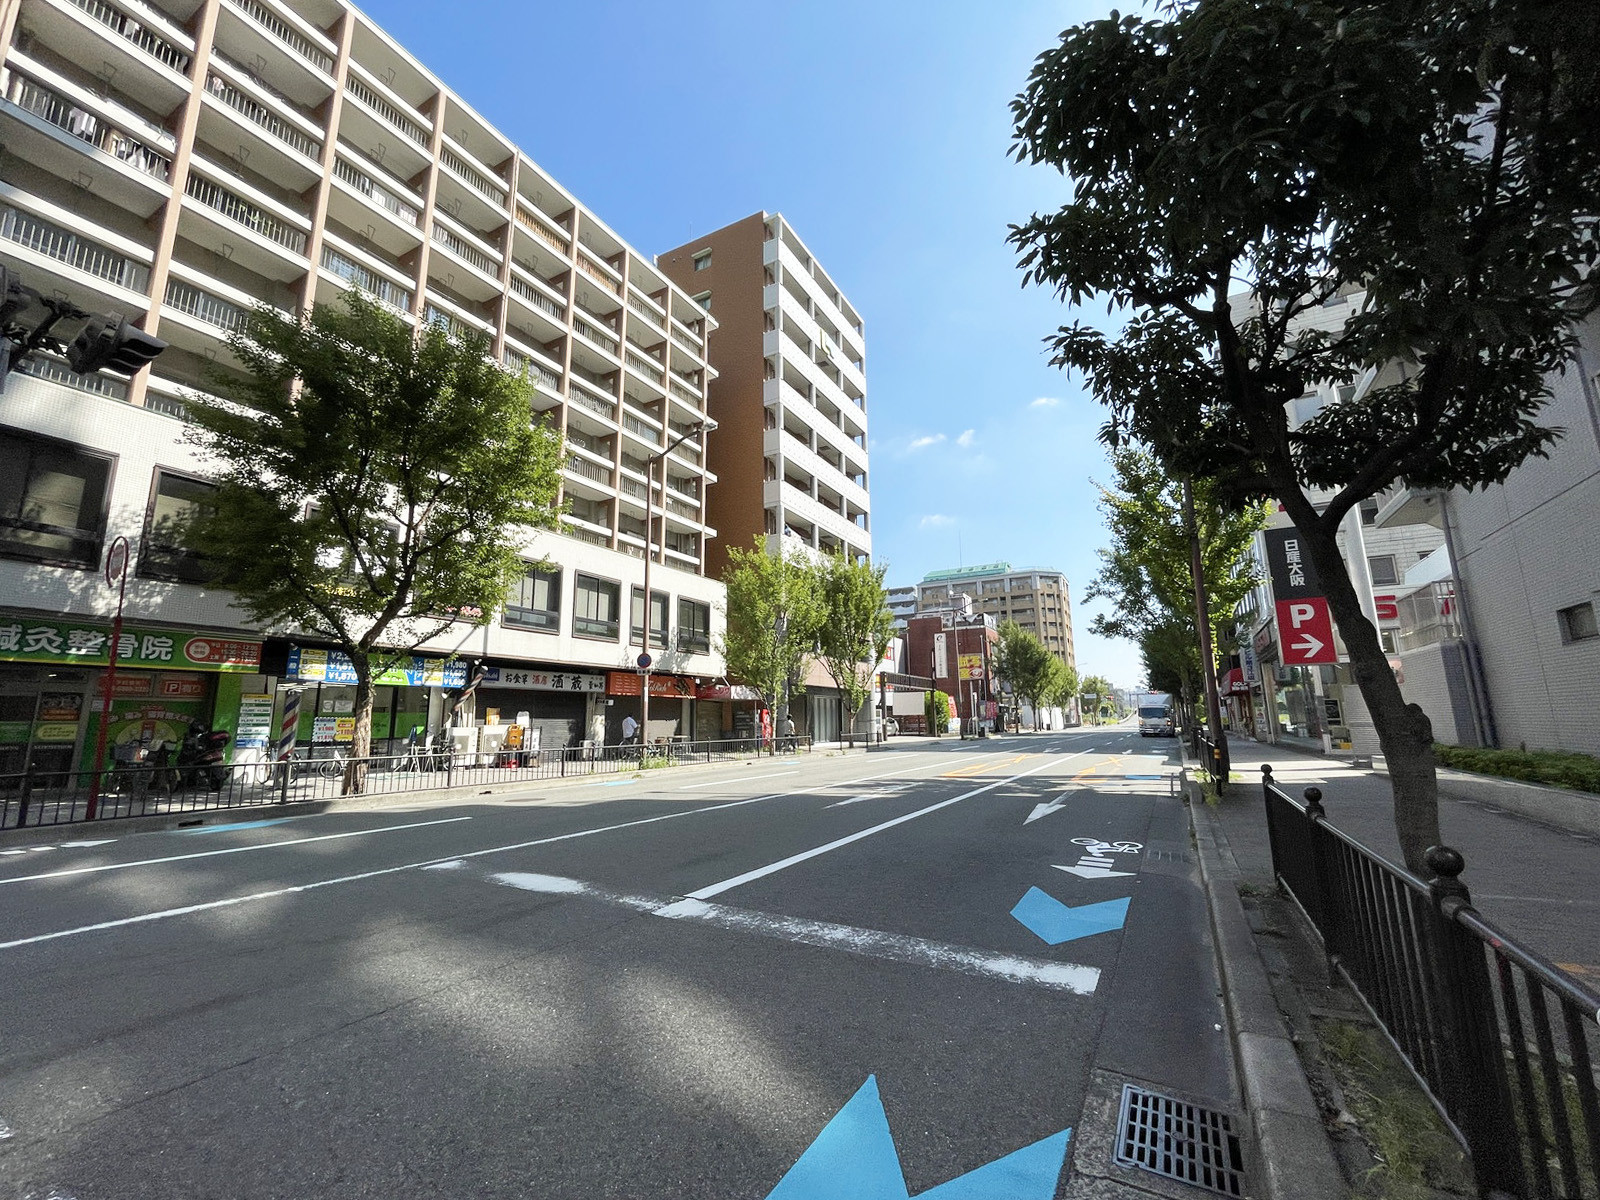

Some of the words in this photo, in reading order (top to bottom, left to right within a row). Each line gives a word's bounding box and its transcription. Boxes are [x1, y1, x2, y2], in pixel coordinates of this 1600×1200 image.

[1284, 539, 1306, 587] 日産大阪
[1290, 603, 1315, 629] P
[328, 671, 358, 681] ¥1,870
[505, 672, 529, 684] お食事
